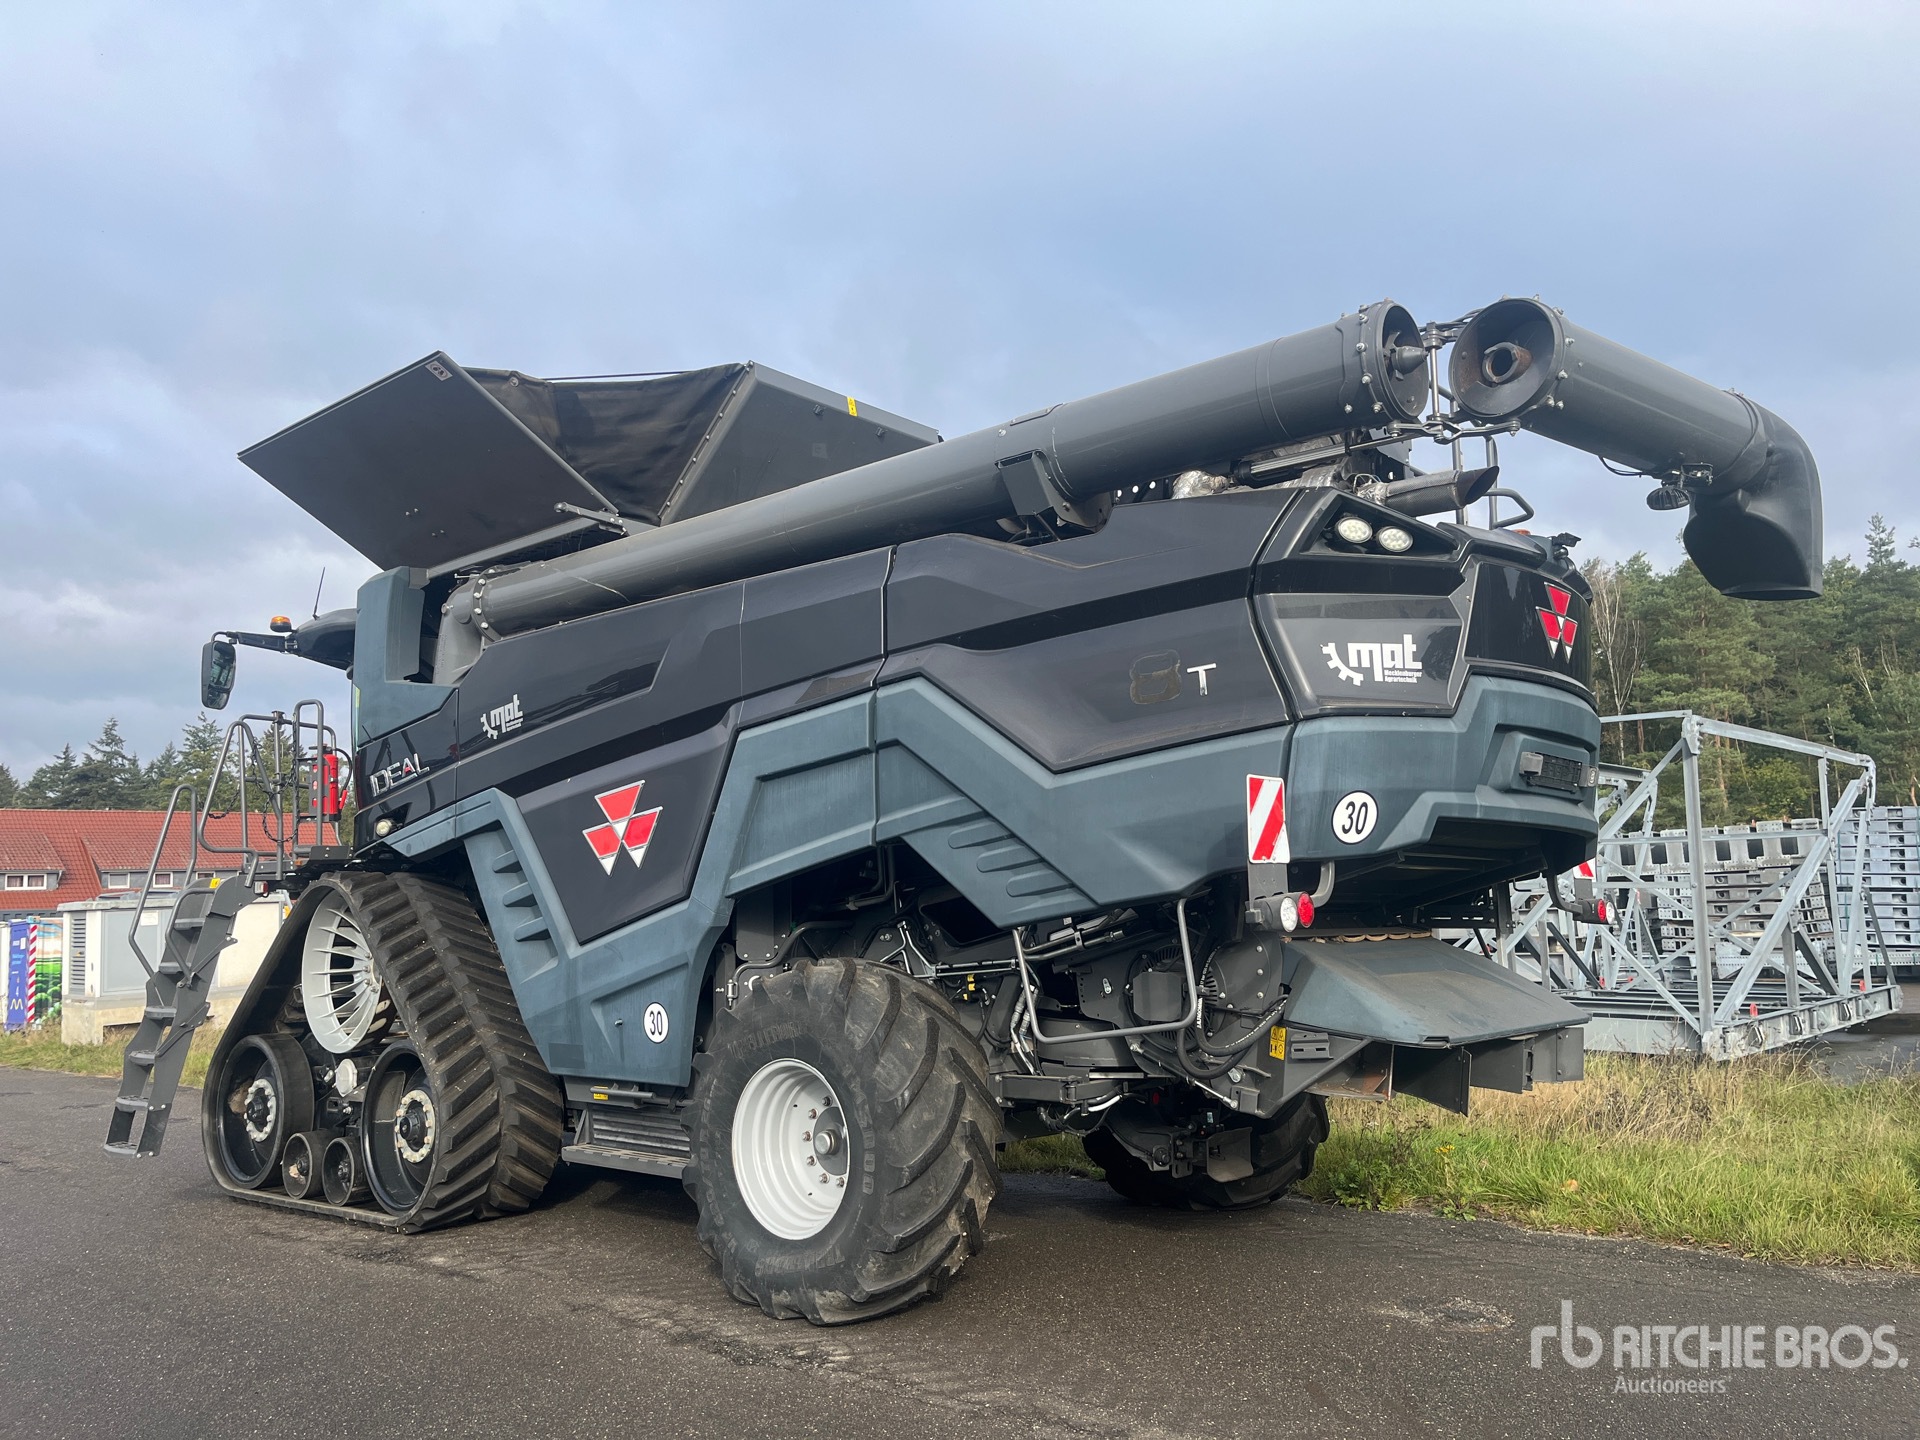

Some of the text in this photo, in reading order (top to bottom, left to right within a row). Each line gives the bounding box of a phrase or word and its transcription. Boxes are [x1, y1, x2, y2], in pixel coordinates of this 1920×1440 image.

[369, 753, 430, 797] IDEAL
[1341, 800, 1369, 835] 30
[649, 1010, 664, 1036] 30
